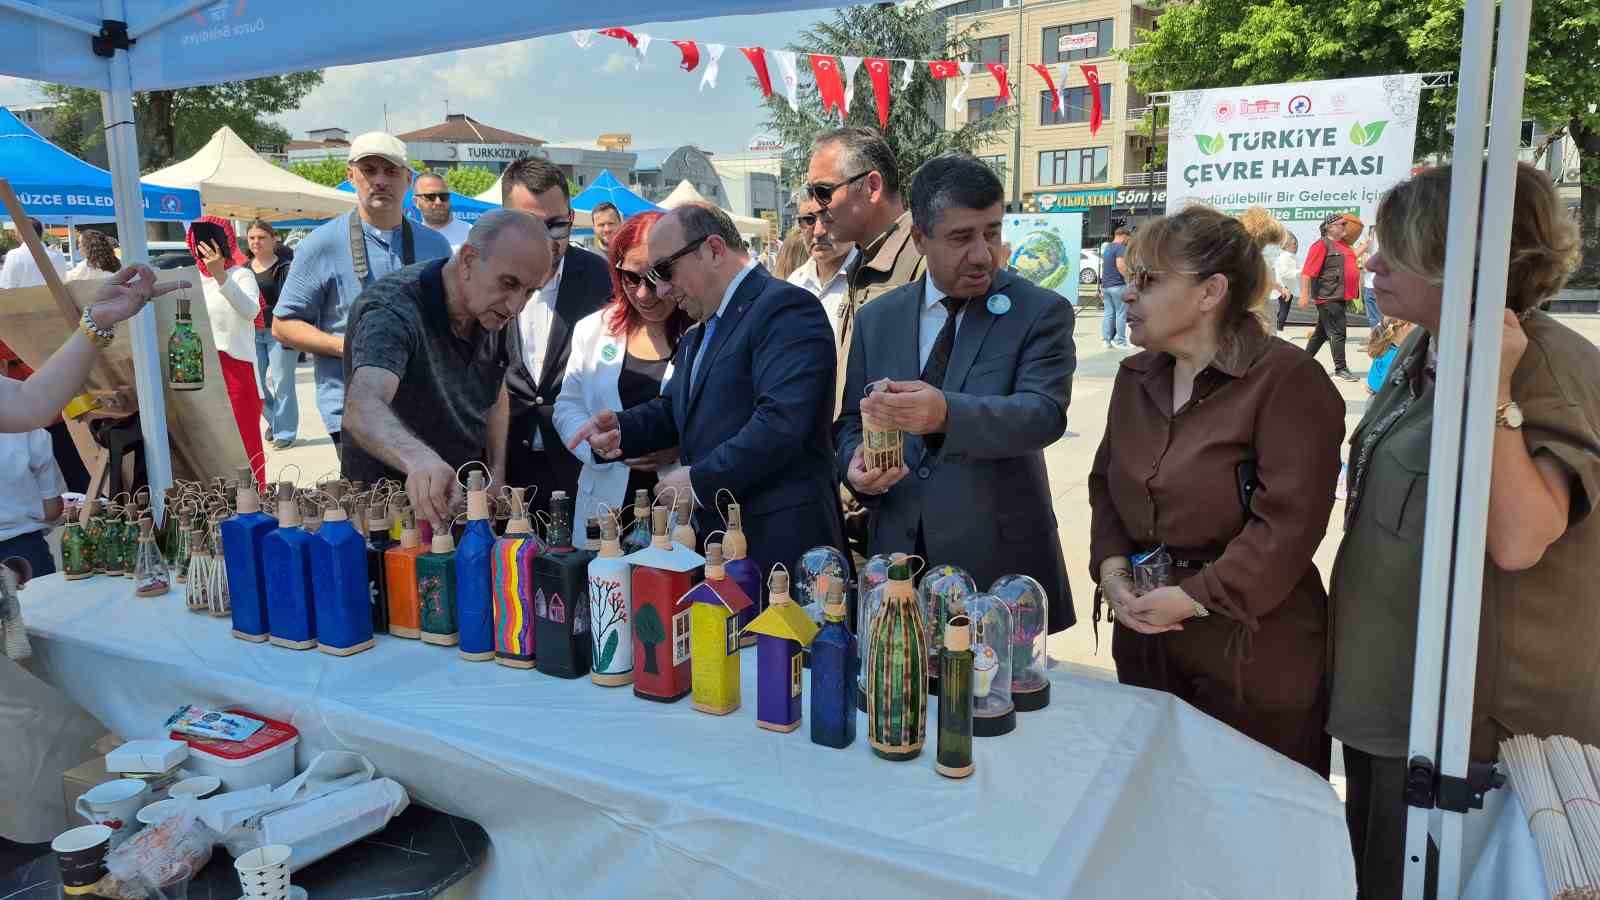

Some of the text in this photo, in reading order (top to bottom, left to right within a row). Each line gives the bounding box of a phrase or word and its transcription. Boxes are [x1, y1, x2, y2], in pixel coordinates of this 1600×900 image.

[1228, 127, 1338, 151] TÜRKİYE
[1184, 155, 1384, 187] ÇEVRE HAFTASI
[1116, 189, 1168, 204] Sönme
[1206, 190, 1273, 206] dürülebilir
[1276, 190, 1295, 203] Bir
[1299, 189, 1358, 203] Gelecek
